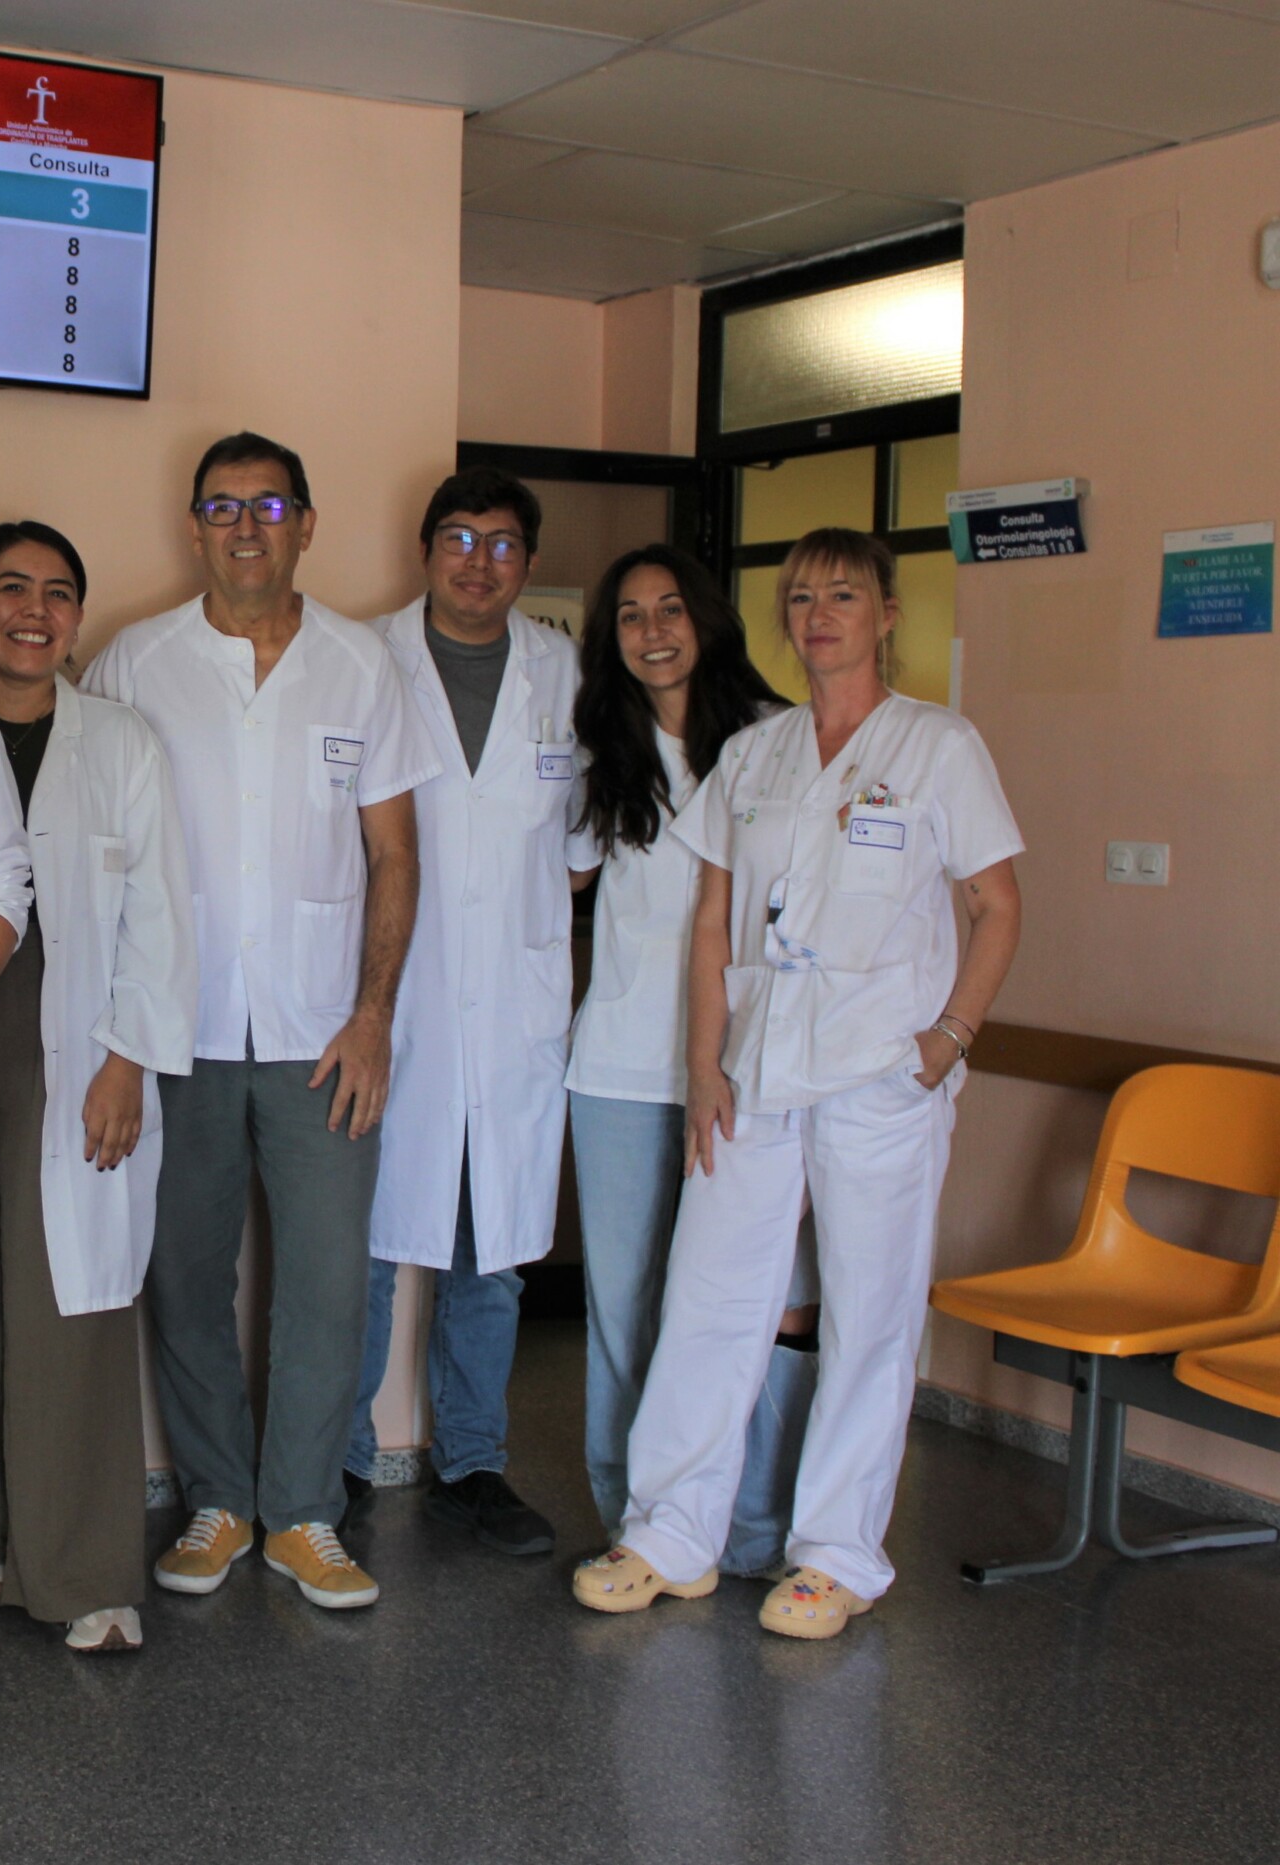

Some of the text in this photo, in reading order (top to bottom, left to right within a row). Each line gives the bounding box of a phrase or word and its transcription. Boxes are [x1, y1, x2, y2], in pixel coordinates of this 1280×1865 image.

[37, 132, 46, 141] DE
[46, 134, 89, 147] TRASPLANTES
[30, 153, 110, 178] Consulta
[71, 188, 90, 219] 3
[68, 237, 80, 257] 8
[66, 267, 78, 286] 8
[65, 296, 77, 315] 8
[64, 325, 76, 344] 8
[63, 354, 75, 373] 8
[1000, 512, 1045, 528] Consulta
[999, 544, 1049, 560] Consultas
[1050, 542, 1056, 554] 1
[1059, 543, 1067, 553] a
[1172, 571, 1208, 583] PUERTA
[1210, 569, 1229, 580] POR
[1184, 584, 1241, 597] SALDREMOS
[1188, 597, 1244, 610] ATENDERLE
[1188, 612, 1244, 625] ENSEGUIDA
